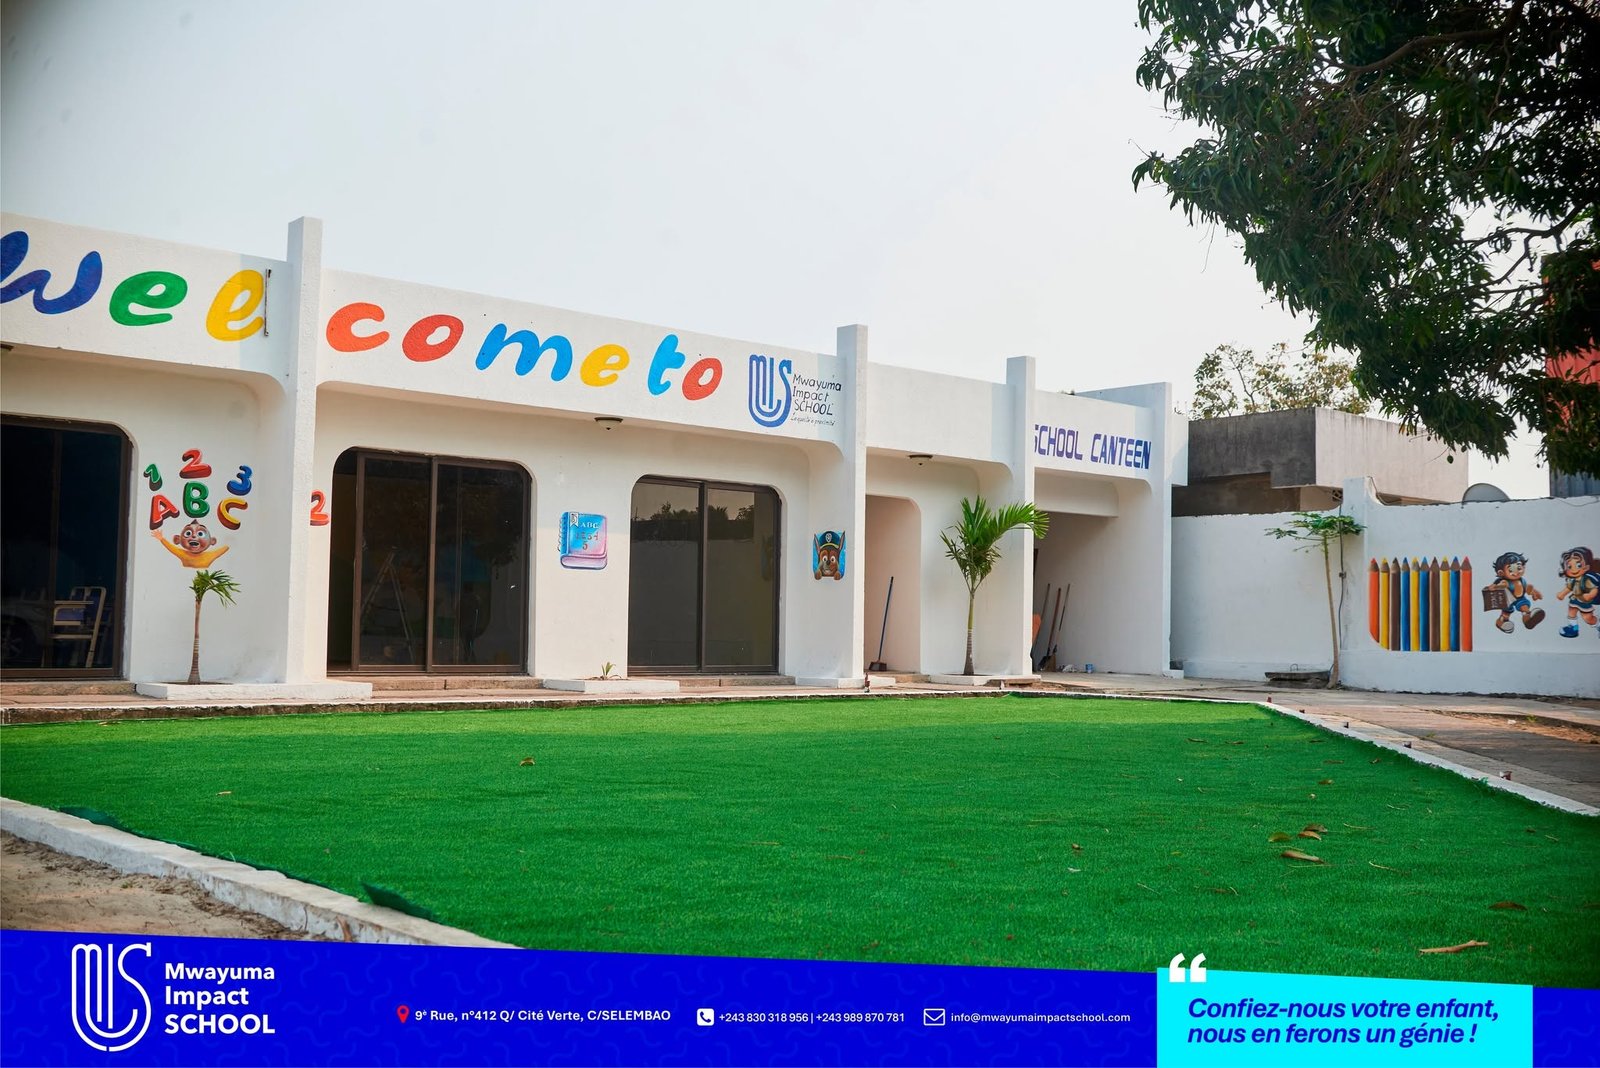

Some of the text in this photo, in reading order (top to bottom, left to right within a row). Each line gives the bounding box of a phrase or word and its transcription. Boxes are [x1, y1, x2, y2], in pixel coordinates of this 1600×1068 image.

[792, 374, 842, 392] Mwayuma
[792, 386, 829, 402] Impact
[793, 399, 834, 416] SCHOOL
[1090, 433, 1152, 470] CANTEEN
